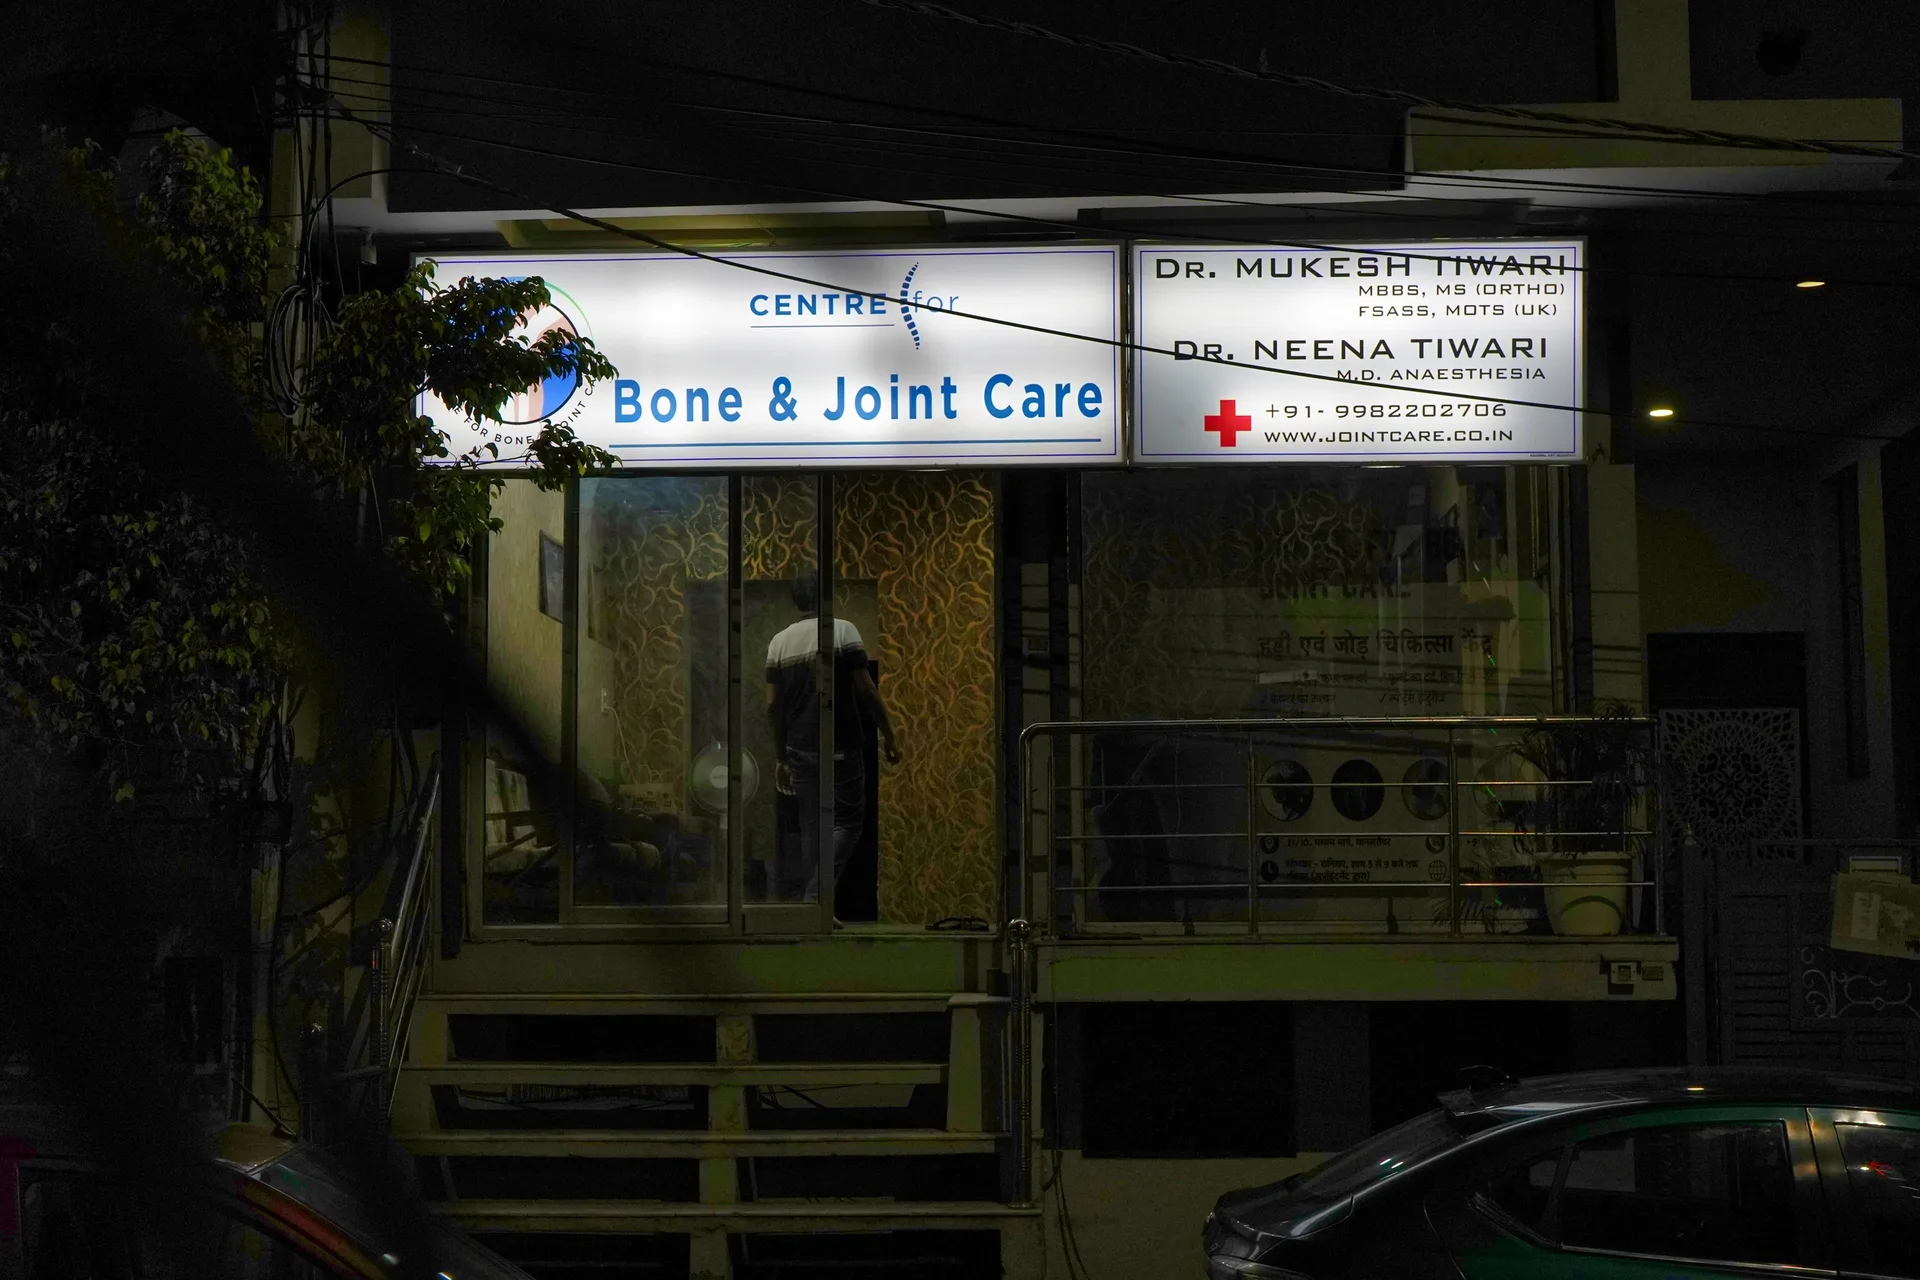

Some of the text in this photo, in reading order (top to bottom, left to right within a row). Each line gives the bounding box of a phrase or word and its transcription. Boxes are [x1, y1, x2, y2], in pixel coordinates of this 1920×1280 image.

[1236, 256, 1411, 278] MUKESH
[1434, 255, 1565, 276] TIWARI
[1359, 283, 1565, 298] MBBS, MS (ORTHO)
[749, 290, 959, 316] CENTRE for
[1359, 304, 1557, 318] FSASS, MOTS (UK)
[1254, 339, 1395, 360] NEENA
[1410, 338, 1547, 359] TIWARI
[1337, 368, 1546, 381] M.D. ANAESTHESIA
[614, 373, 1103, 423] Bone & Joint Care
[1335, 403, 1507, 419] 9982202706
[464, 416, 489, 437] FOR
[494, 433, 534, 445] BONE
[1264, 430, 1513, 443] WWW.JOINTCARE.CO.IN
[1299, 629, 1326, 656] एवं
[1332, 628, 1369, 660] जोड़
[1376, 627, 1453, 654] चिकित्सा
